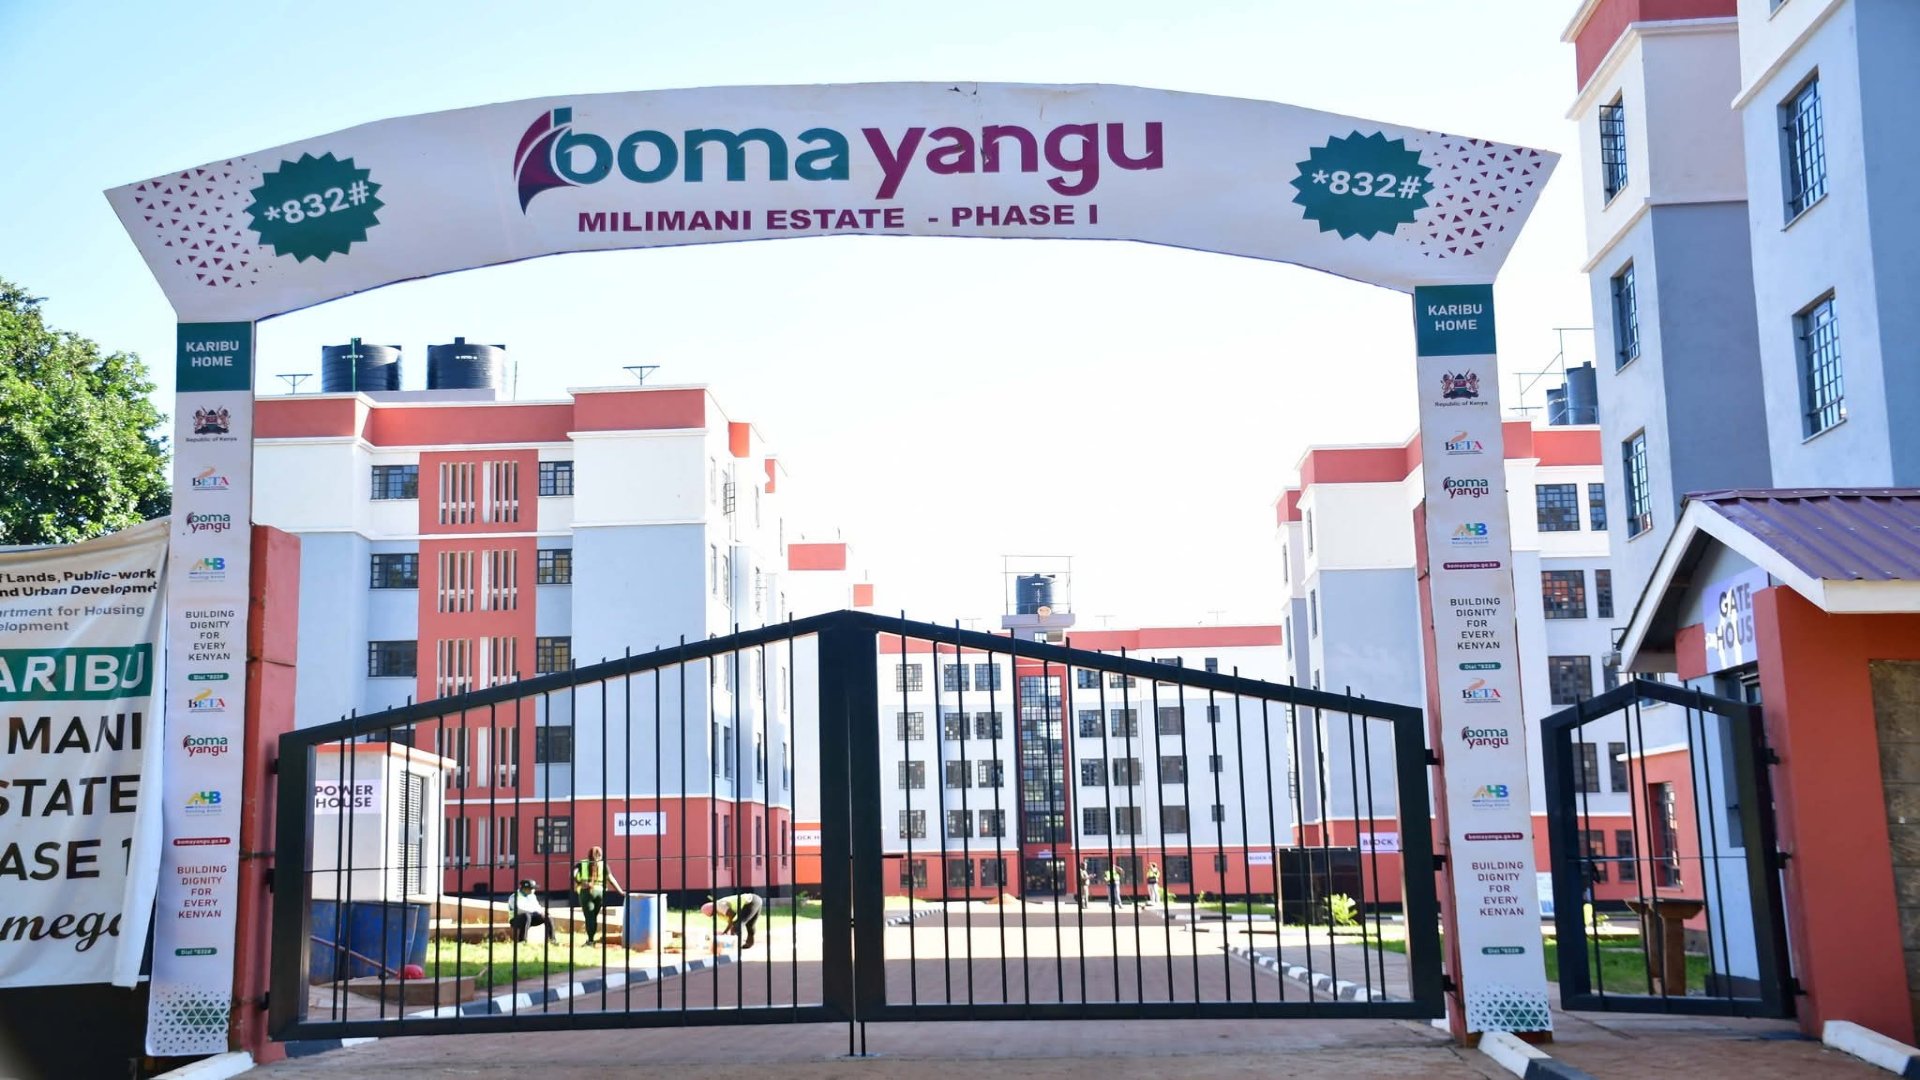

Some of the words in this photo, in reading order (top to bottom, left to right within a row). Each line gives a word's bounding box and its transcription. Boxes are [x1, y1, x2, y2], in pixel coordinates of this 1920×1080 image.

[578, 210, 751, 232] MILIMANI
[766, 208, 904, 230] ESTATE
[952, 204, 1075, 227] PHASE
[1428, 304, 1482, 316] KARIBU
[1435, 320, 1478, 331] HOME
[185, 340, 240, 352] KARIBU
[191, 356, 233, 368] HOME
[1445, 440, 1483, 451] BETA
[192, 476, 229, 486] BETA
[1448, 486, 1489, 499] yangu
[191, 522, 231, 534] yangu
[7, 572, 61, 584] Lands,
[23, 584, 67, 596] Urban
[1450, 598, 1500, 606] BUILDING
[1719, 582, 1750, 618] GATE
[58, 606, 80, 616] for
[84, 604, 145, 617] Housing
[185, 610, 235, 618] BUILDING
[1456, 608, 1496, 617] DIGNITY
[190, 620, 230, 629] DIGNITY
[1466, 620, 1488, 628] FOR
[1461, 630, 1495, 639] EVERY
[193, 642, 226, 650] EVERY
[1457, 642, 1500, 650] KENYAN
[188, 652, 231, 661] KENYAN
[1462, 689, 1502, 699] BETA
[188, 698, 225, 708] BETA
[1466, 737, 1509, 750] yangu
[188, 745, 228, 757] yangu
[618, 819, 652, 827] BOCK
[177, 865, 227, 874] BUILDING
[1472, 861, 1524, 870] BUILDING
[182, 876, 222, 886] DIGNITY
[1478, 873, 1520, 882] DIGNITY
[191, 888, 212, 896] FOR
[1489, 884, 1510, 893] FOR
[184, 899, 218, 908] EVERY
[1484, 896, 1518, 904] EVERY
[178, 910, 222, 919] KENYAN
[1480, 907, 1524, 916] KENYAN
